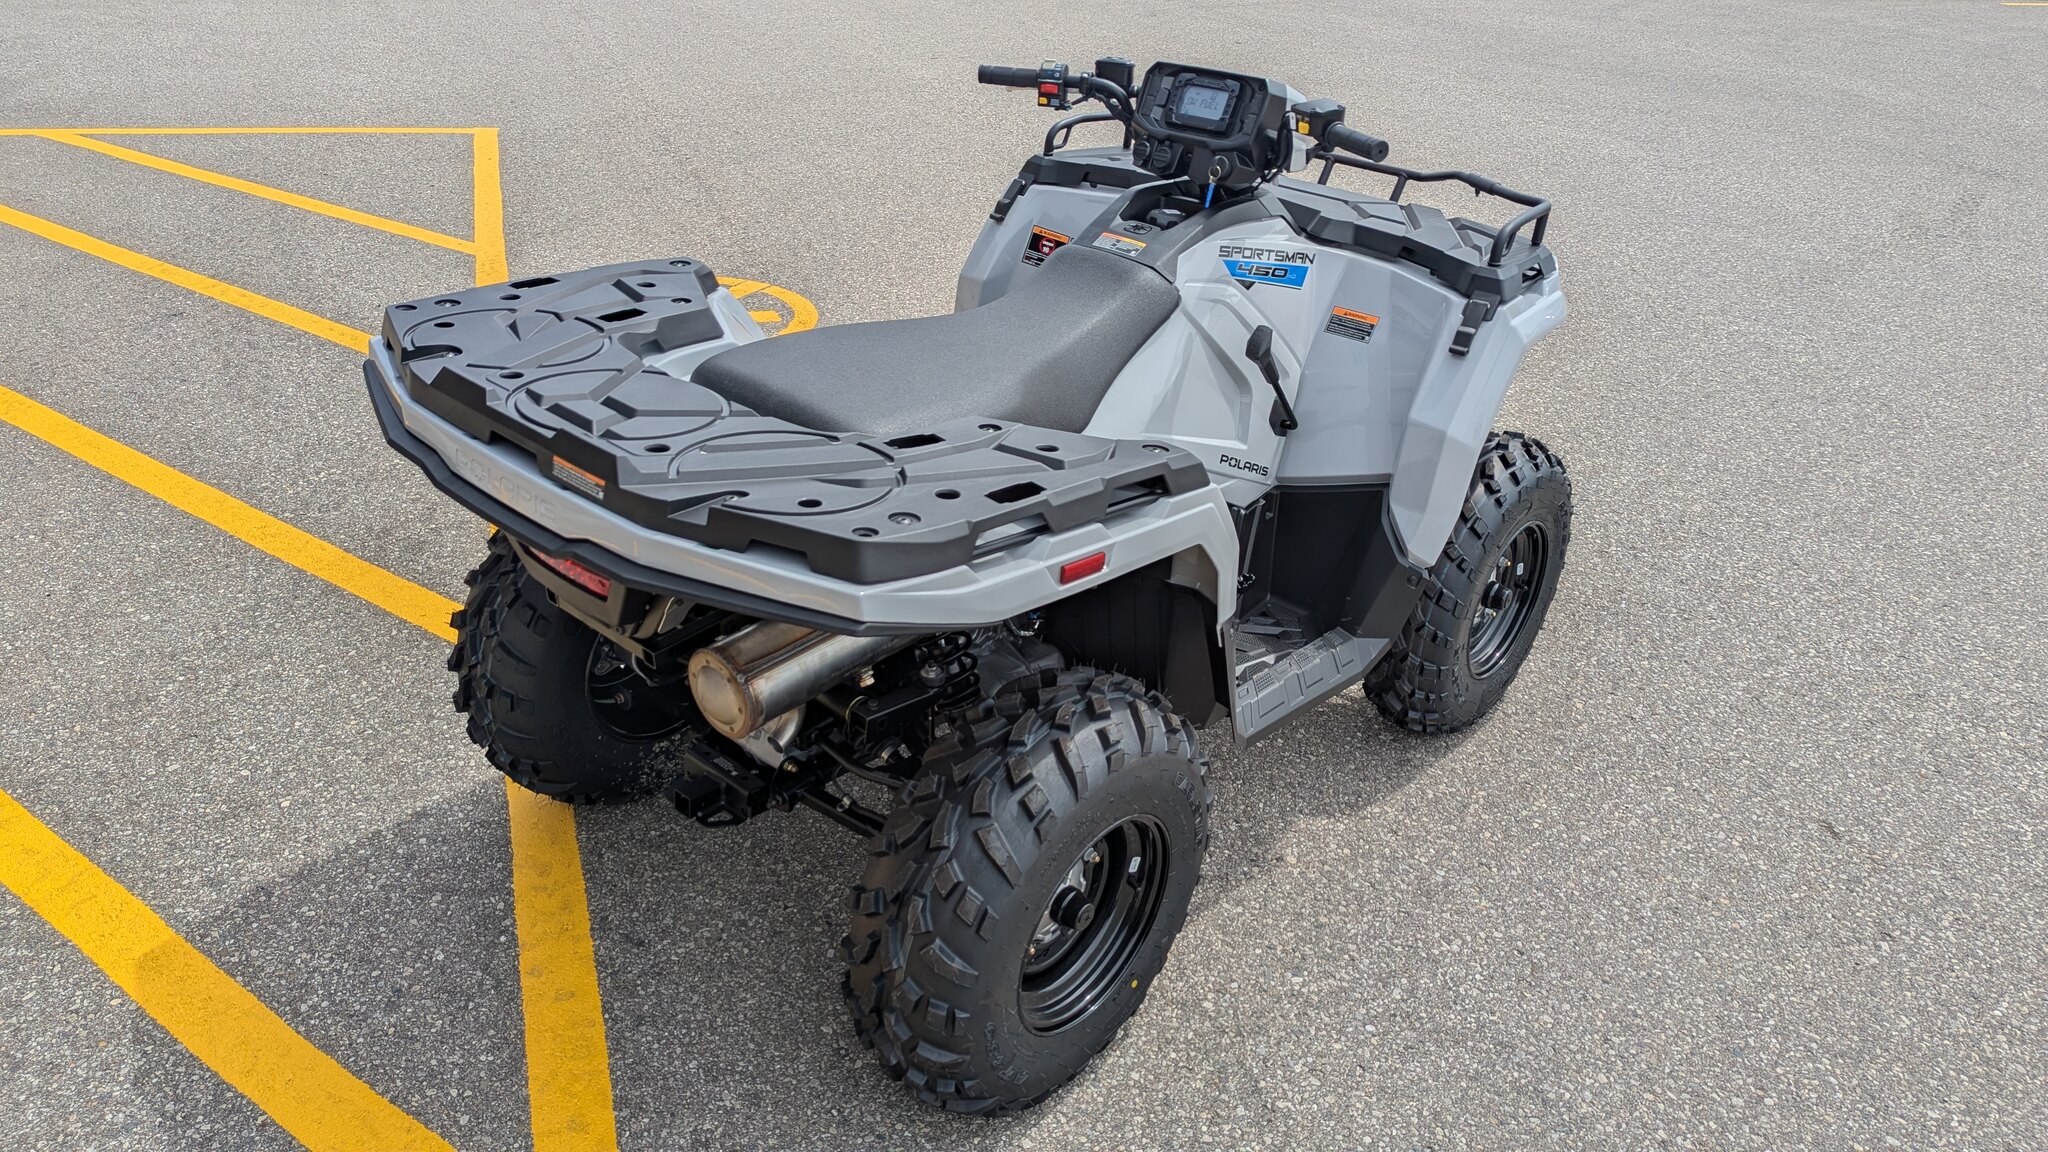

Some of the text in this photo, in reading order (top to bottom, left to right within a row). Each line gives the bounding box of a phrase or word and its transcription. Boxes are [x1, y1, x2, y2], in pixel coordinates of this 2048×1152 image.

[1218, 245, 1316, 265] SPORTSMAN
[1236, 263, 1289, 279] 450
[1219, 454, 1269, 477] POLARIS
